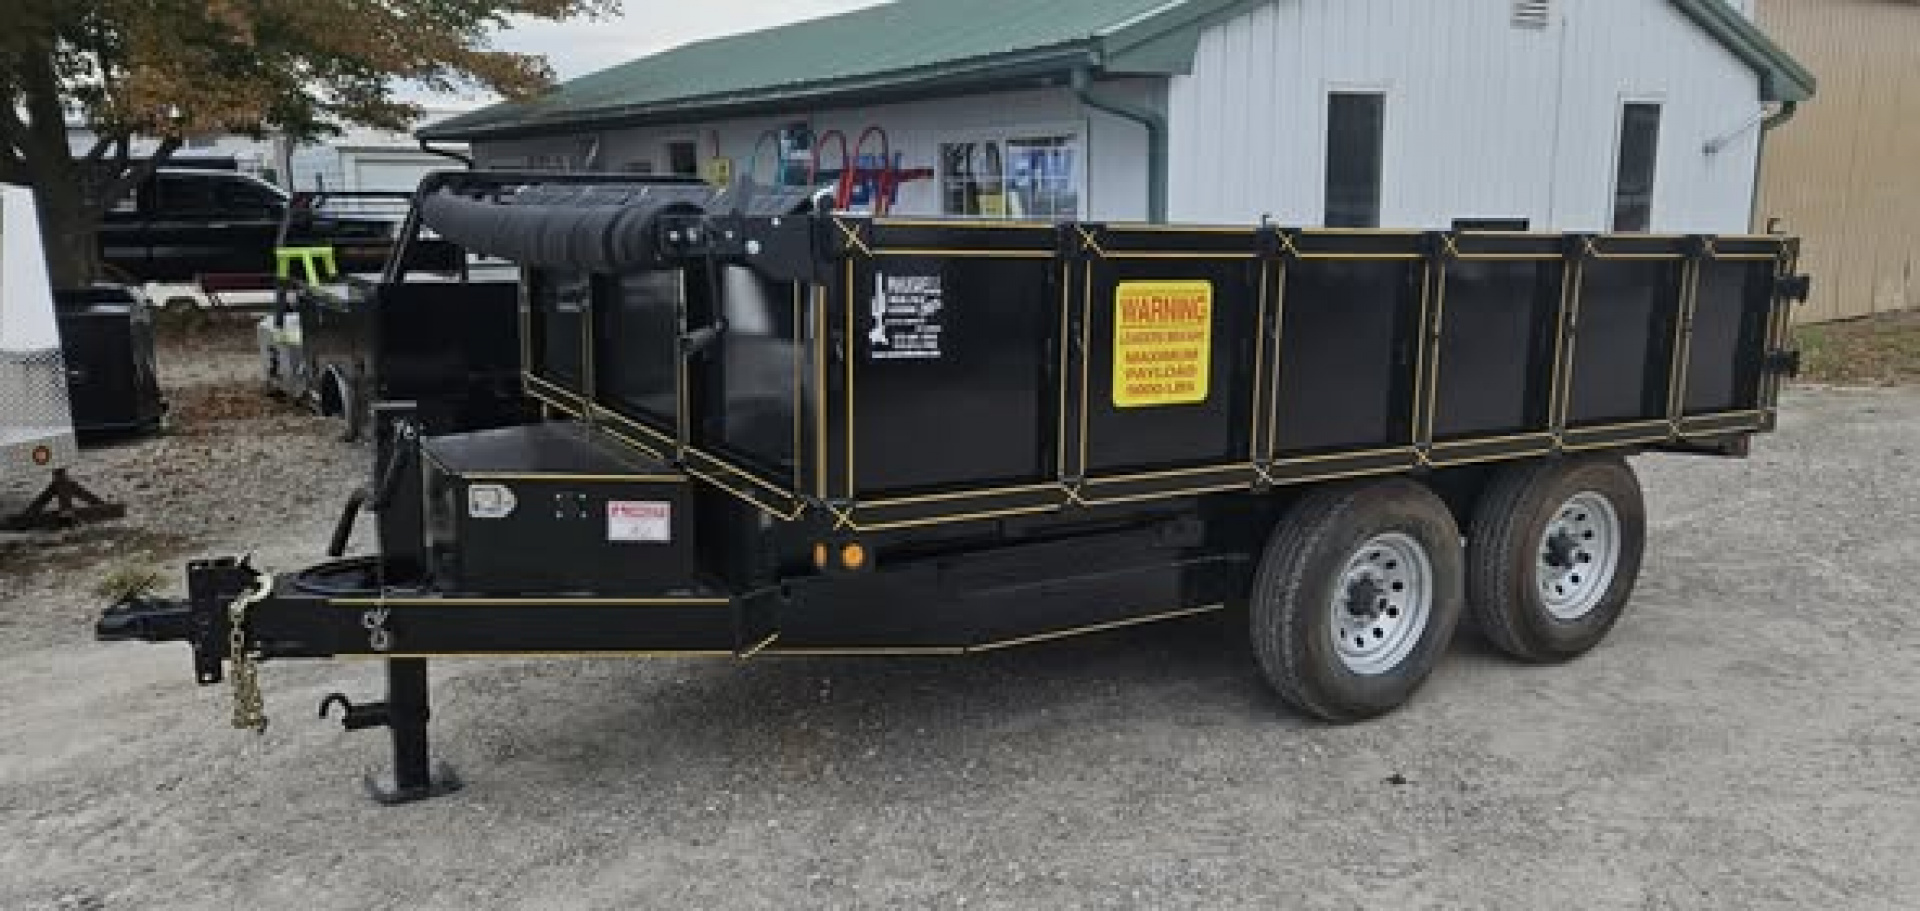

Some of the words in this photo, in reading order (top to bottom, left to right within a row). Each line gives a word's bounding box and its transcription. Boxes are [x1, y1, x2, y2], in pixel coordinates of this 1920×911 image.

[1120, 295, 1208, 323] WARNING
[1125, 349, 1199, 364] MAXIMUM
[1125, 365, 1198, 380] PAYLOAD
